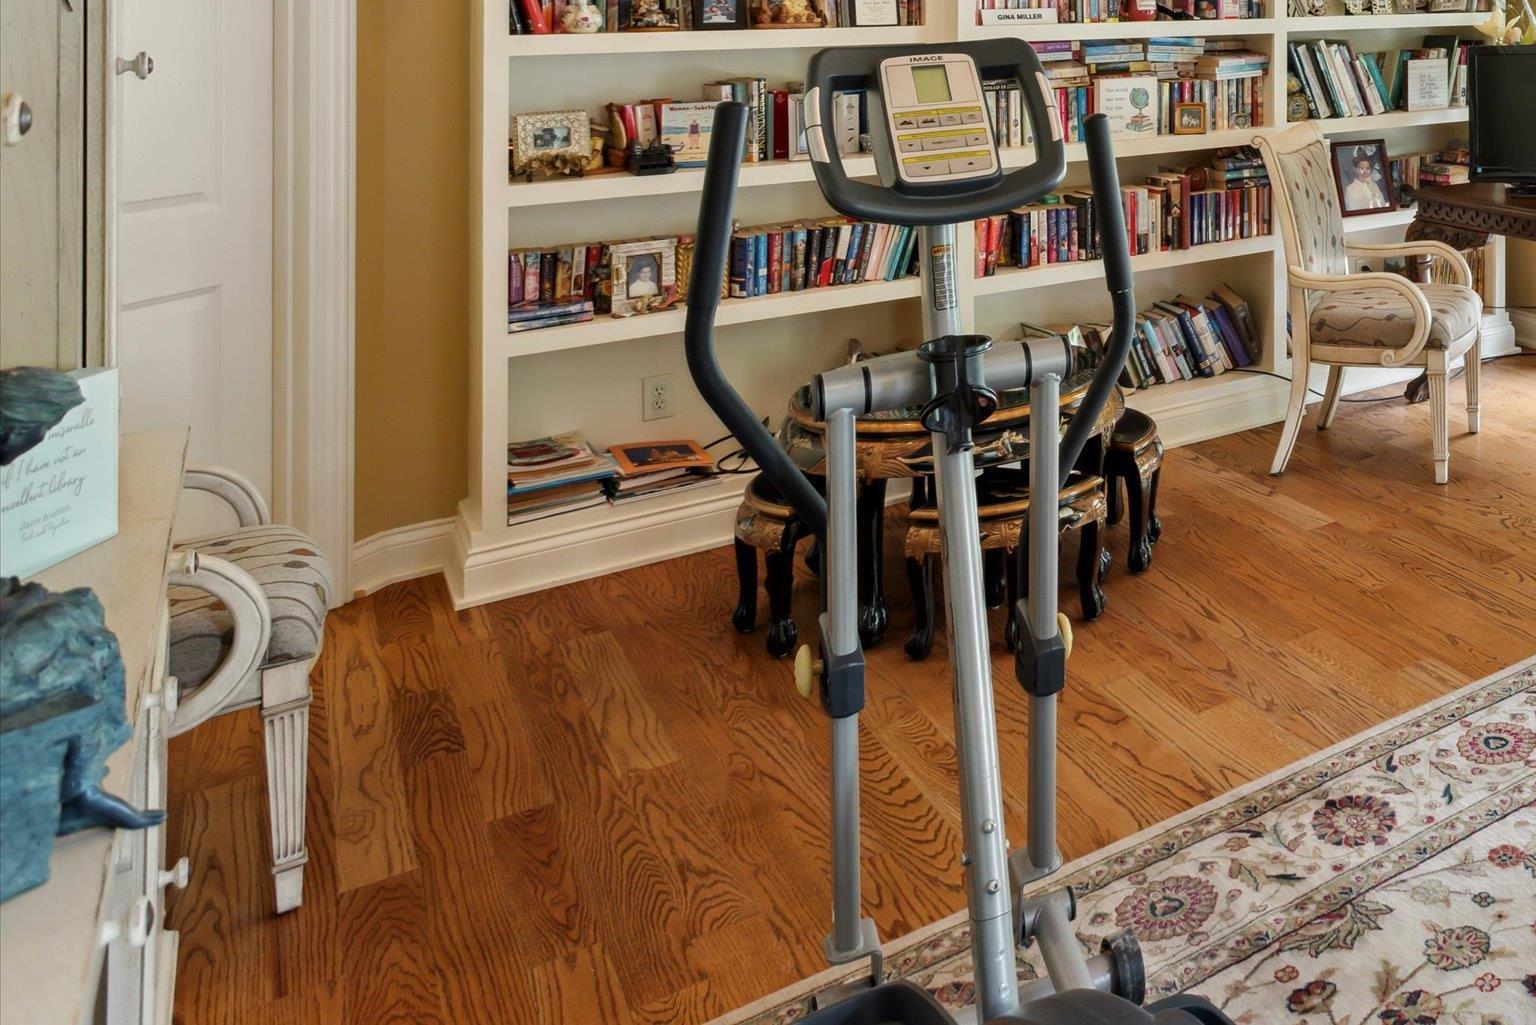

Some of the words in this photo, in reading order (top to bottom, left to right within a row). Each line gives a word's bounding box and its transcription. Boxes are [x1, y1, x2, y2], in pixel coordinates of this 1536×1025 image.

[909, 55, 944, 63] IMAGE
[758, 112, 766, 152] WINNING
[48, 408, 95, 440] miserable
[25, 456, 51, 474] have
[54, 446, 73, 464] not
[73, 448, 87, 458] an
[1, 481, 48, 513] excellent
[48, 470, 86, 497] library
